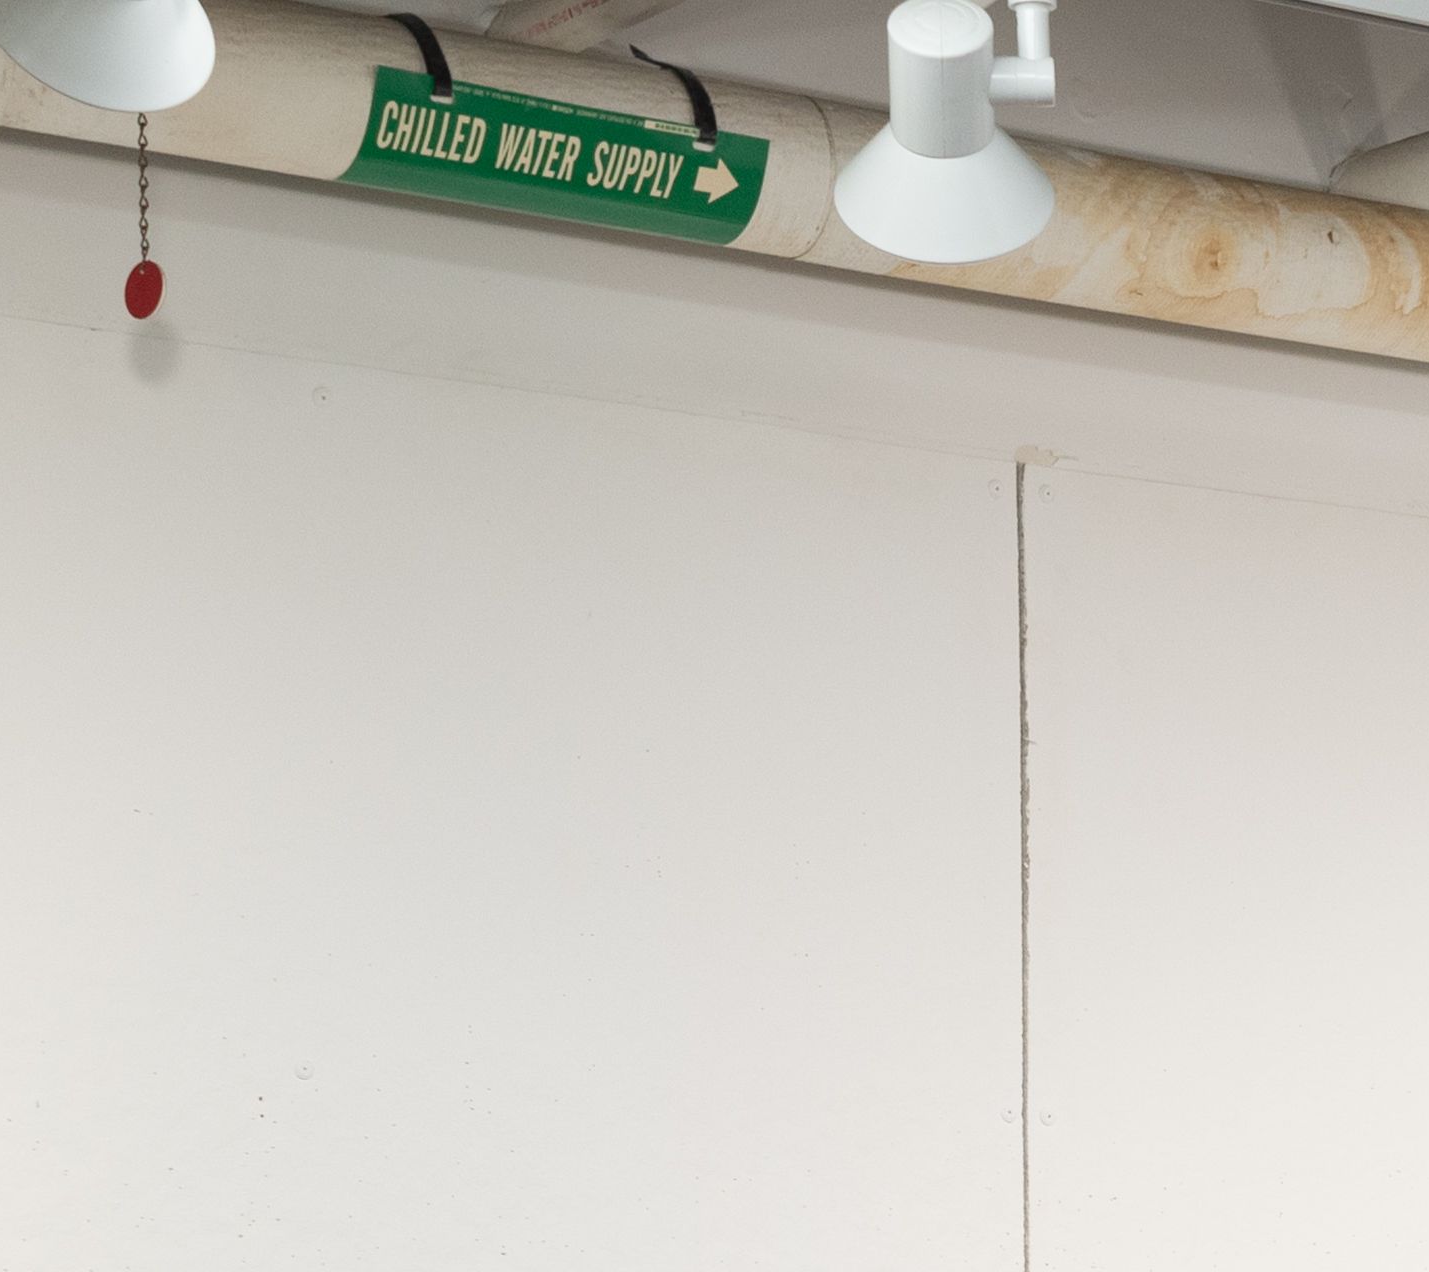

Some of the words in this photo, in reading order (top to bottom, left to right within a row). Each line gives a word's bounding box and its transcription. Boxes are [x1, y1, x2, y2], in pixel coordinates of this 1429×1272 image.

[376, 100, 487, 164] CHILLED
[495, 123, 581, 181] WATER
[586, 141, 684, 199] SUPPLY
